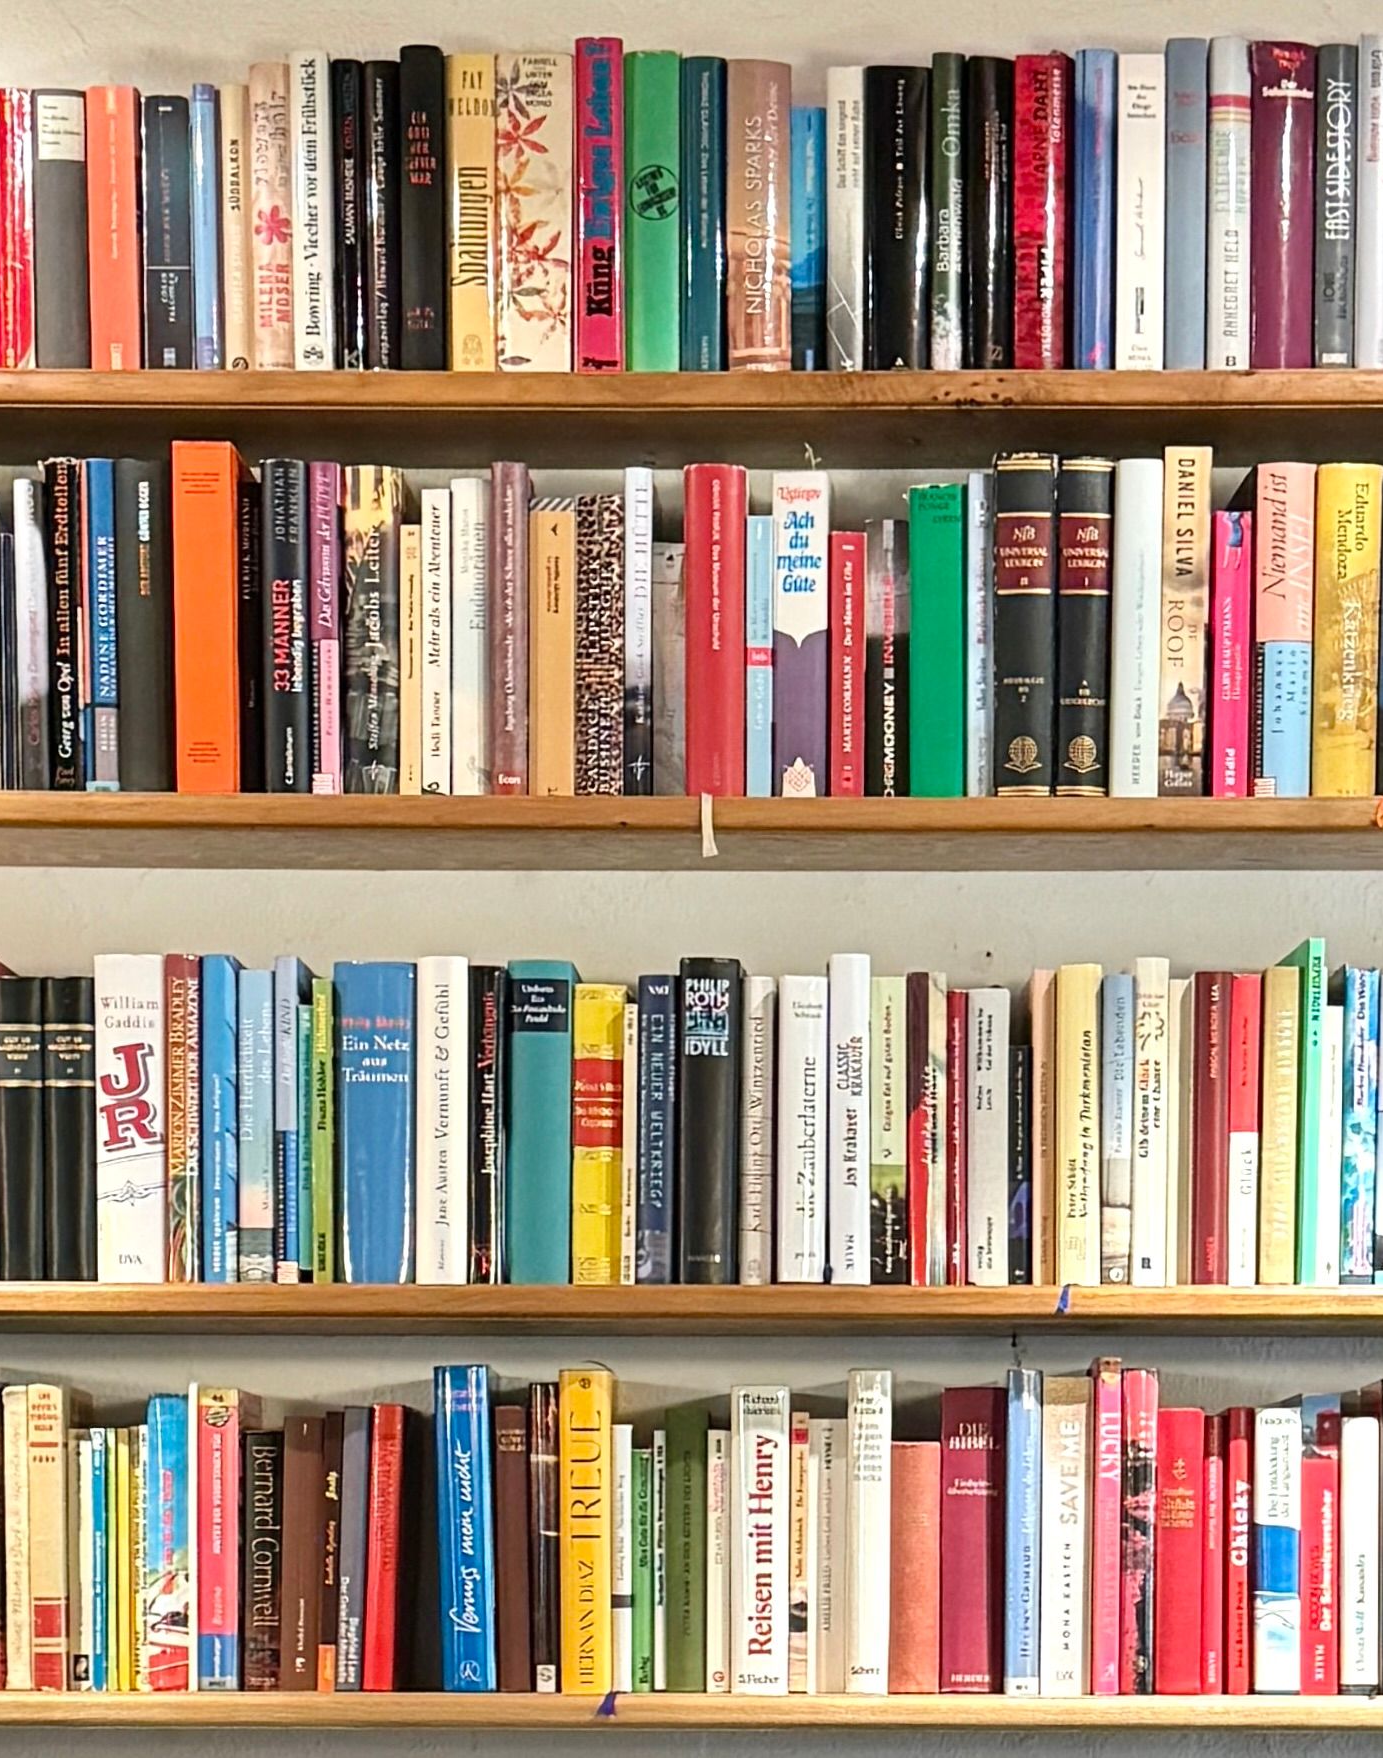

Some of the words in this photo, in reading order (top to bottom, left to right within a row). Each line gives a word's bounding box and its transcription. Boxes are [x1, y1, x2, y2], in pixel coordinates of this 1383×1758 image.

[300, 58, 318, 135] Frühstück
[941, 89, 961, 157] Omka
[229, 139, 241, 211] SÜDBALKON
[303, 141, 317, 172] dem
[745, 116, 761, 189] SPARKS
[305, 174, 318, 199] vor
[303, 205, 319, 260] Viecher
[450, 166, 497, 286] Spaltungen
[937, 209, 950, 272] Barbara
[586, 246, 614, 317] Küng
[745, 201, 762, 314] NICHOLAS
[259, 263, 274, 328] MILENA
[276, 263, 290, 324] MOSER
[305, 272, 322, 336] Bowring
[53, 462, 70, 545] Erdteilen
[274, 467, 286, 543] JONATHAN
[1177, 458, 1196, 519] DANIEL
[1263, 473, 1286, 493] ist
[427, 504, 441, 577] Abenteuer
[633, 482, 648, 554] HÜTTE
[782, 510, 815, 531] Ach
[789, 531, 810, 550] du
[54, 549, 70, 585] fünf
[777, 553, 822, 572] meine
[1174, 529, 1193, 576] SILVA
[1262, 496, 1287, 599] Niemand
[291, 579, 305, 637] begraben
[427, 581, 441, 603] ein
[634, 564, 648, 599] DIE
[782, 574, 817, 594] Güte
[56, 589, 70, 631] allen
[270, 579, 290, 663] MÄNNER
[427, 607, 441, 628] als
[56, 636, 70, 655] In
[291, 640, 306, 691] lebendig
[428, 631, 442, 667] Mehr
[55, 659, 72, 691] Opel
[273, 669, 290, 692] 33
[60, 695, 72, 717] von
[883, 682, 895, 764] MOONEY
[498, 772, 522, 785] Econ
[100, 995, 159, 1010] William
[170, 977, 185, 1042] BRADLEY
[434, 983, 450, 1039] Gefühl
[684, 978, 731, 993] PHILIP
[684, 992, 730, 1012] ROTH
[239, 1017, 253, 1108] Herrlichkeit
[342, 1035, 369, 1052] Ein
[373, 1035, 410, 1052] Netz
[361, 1055, 387, 1068] aus
[434, 1045, 449, 1060] &
[684, 1036, 729, 1057] IDYLL
[836, 1043, 850, 1090] CLASSIC
[849, 1036, 864, 1096] KRAKAUER
[169, 1047, 185, 1109] ZIMMER
[342, 1067, 409, 1084] Träumen
[240, 1113, 253, 1141] Die
[434, 1068, 449, 1139] Vernunft
[170, 1111, 185, 1175] MARION
[947, 1435, 1001, 1452] BIBEL
[958, 1421, 988, 1435] DIE
[1059, 1420, 1080, 1458] ME
[1100, 1412, 1122, 1480] LUCKY
[251, 1446, 281, 1529] Bernard
[456, 1439, 473, 1501] nicht
[569, 1410, 602, 1549] TREUE
[748, 1435, 778, 1515] Henry
[1059, 1465, 1078, 1525] SAVE
[459, 1507, 476, 1555] mein
[747, 1523, 774, 1563] mit
[1229, 1480, 1251, 1566] Chicky
[251, 1538, 279, 1627] Cornwell
[578, 1560, 593, 1603] DIAZ
[1063, 1542, 1072, 1598] KASTEN
[448, 1566, 482, 1634] Vermiss
[747, 1572, 774, 1656] Reisen
[1062, 1608, 1071, 1650] MONA
